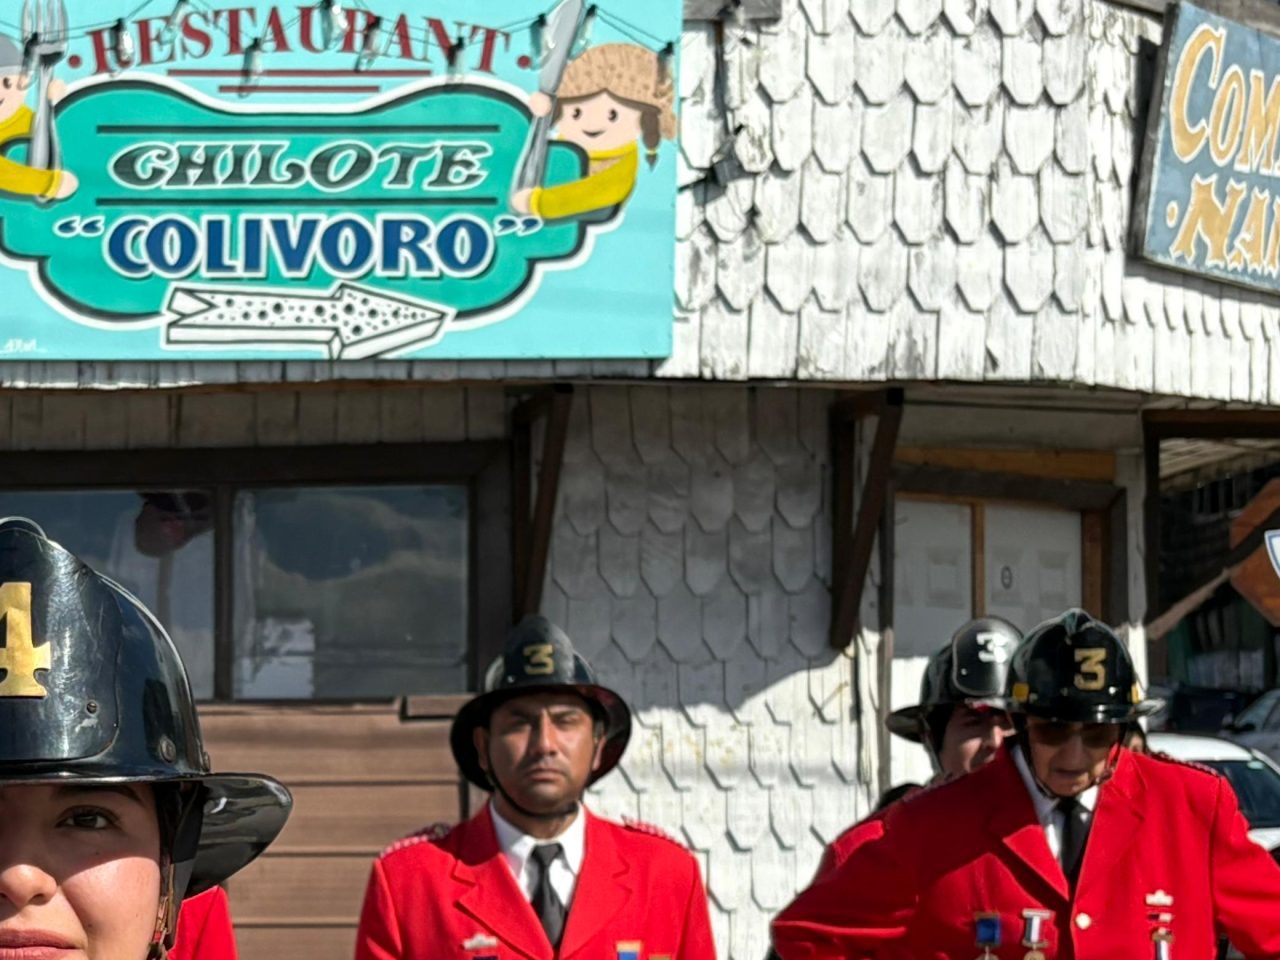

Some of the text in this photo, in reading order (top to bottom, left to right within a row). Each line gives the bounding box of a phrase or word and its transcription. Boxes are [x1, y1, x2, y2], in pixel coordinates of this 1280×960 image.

[86, 6, 511, 76] RESTAURANT
[1170, 23, 1280, 178] COM
[108, 141, 493, 193] CHILOTE
[523, 644, 554, 675] 3
[976, 632, 1009, 663] 3
[1074, 648, 1106, 690] 3
